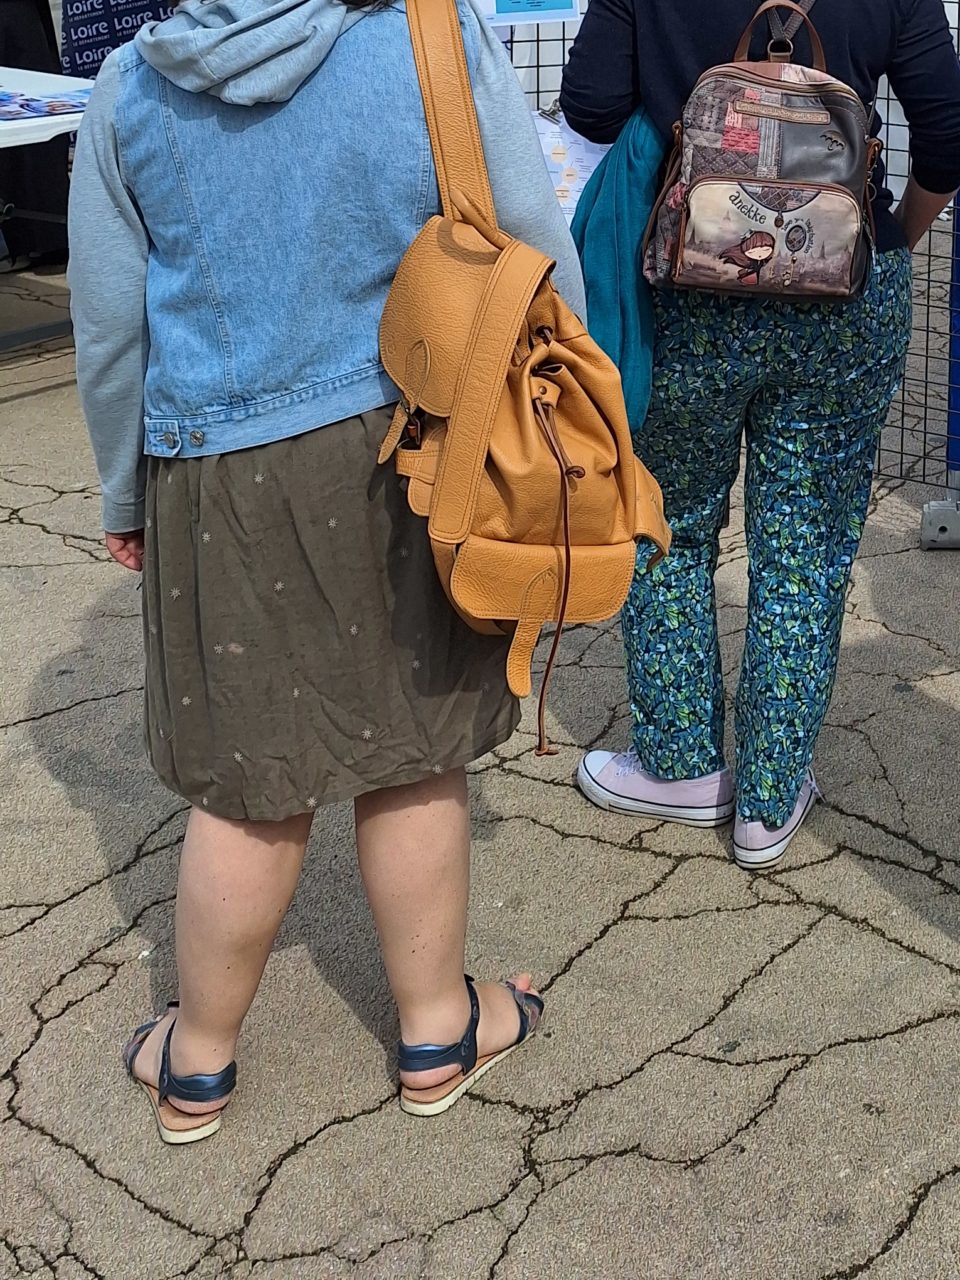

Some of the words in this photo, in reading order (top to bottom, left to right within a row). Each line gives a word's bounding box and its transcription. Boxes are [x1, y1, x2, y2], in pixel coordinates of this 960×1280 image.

[114, 11, 153, 30] Loire
[71, 22, 109, 40] Loire
[728, 190, 767, 225] anekke
